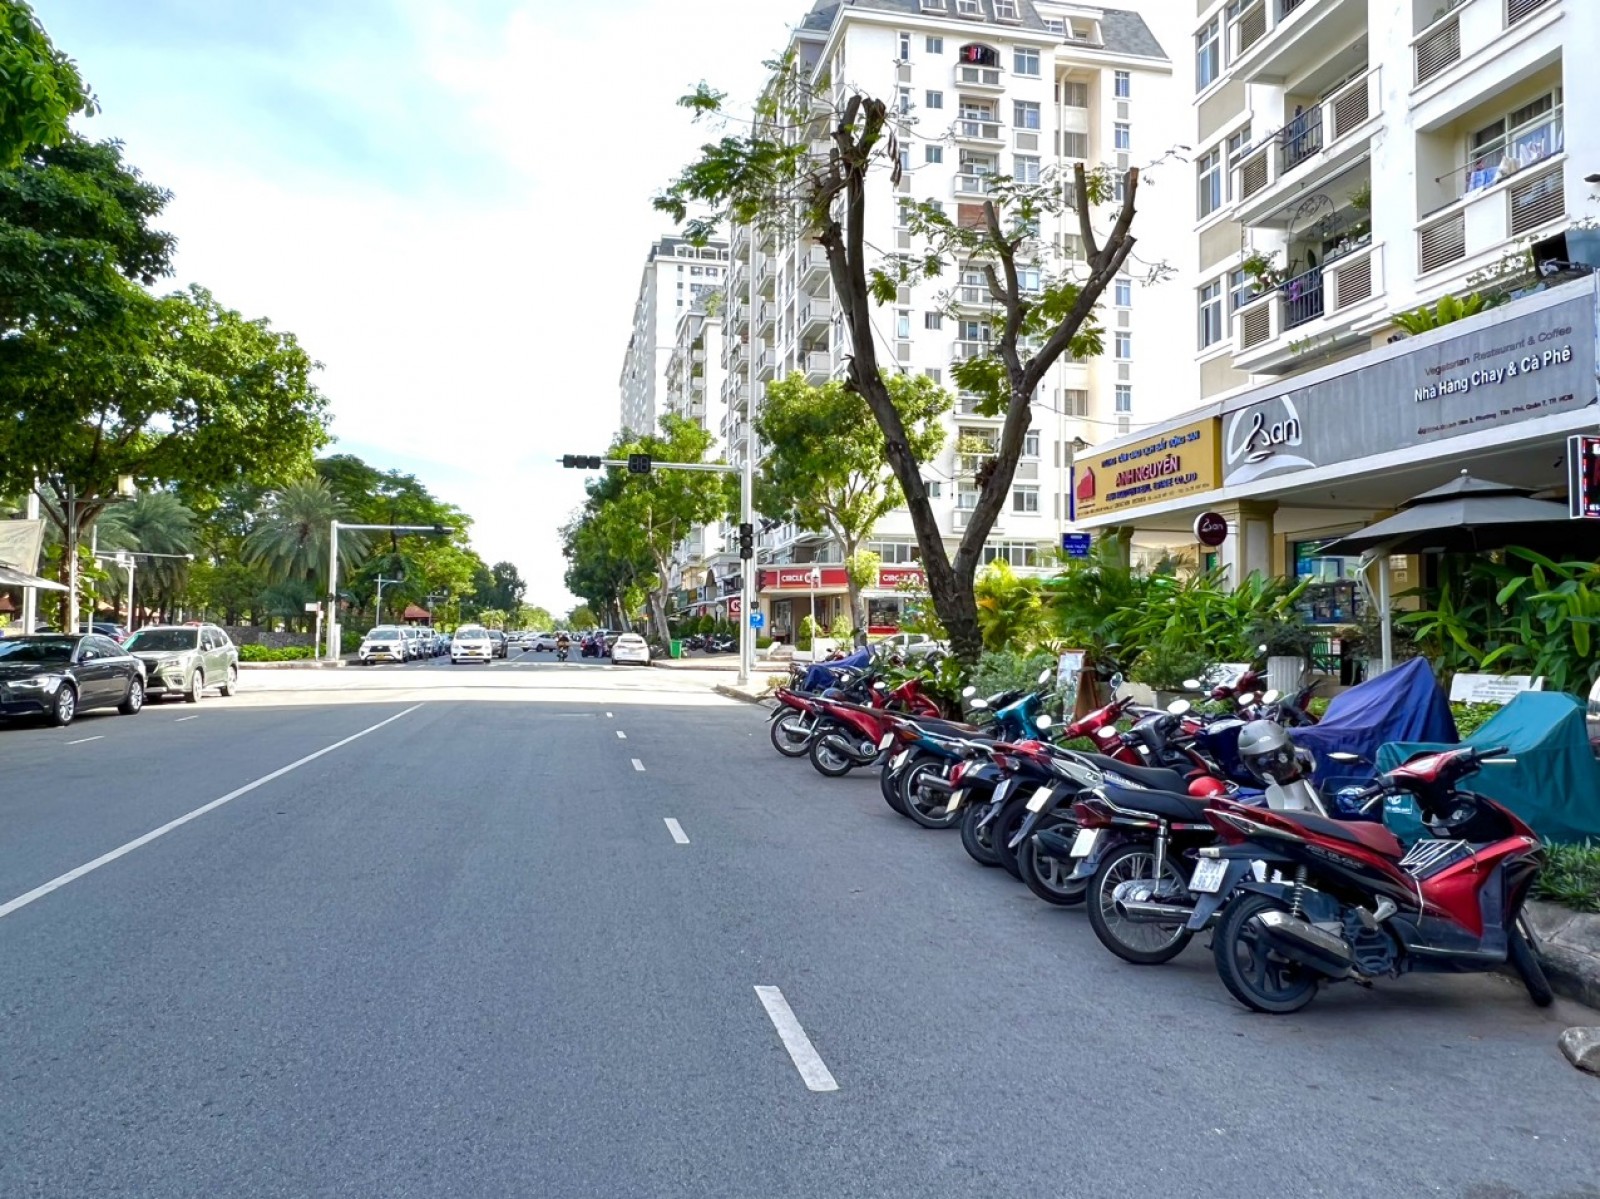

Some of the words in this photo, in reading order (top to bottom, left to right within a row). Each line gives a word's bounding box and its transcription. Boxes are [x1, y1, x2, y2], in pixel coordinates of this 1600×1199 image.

[1414, 384, 1437, 402] Nhà
[1471, 366, 1506, 386] Chay
[1507, 361, 1519, 376] &
[1520, 354, 1541, 373] Cà
[1543, 344, 1573, 367] Phê
[1425, 357, 1470, 376] Vegetarian
[1473, 339, 1525, 362] Restaurant
[1527, 335, 1536, 346] &
[1538, 326, 1572, 342] Coffee
[1116, 468, 1136, 487] ANH
